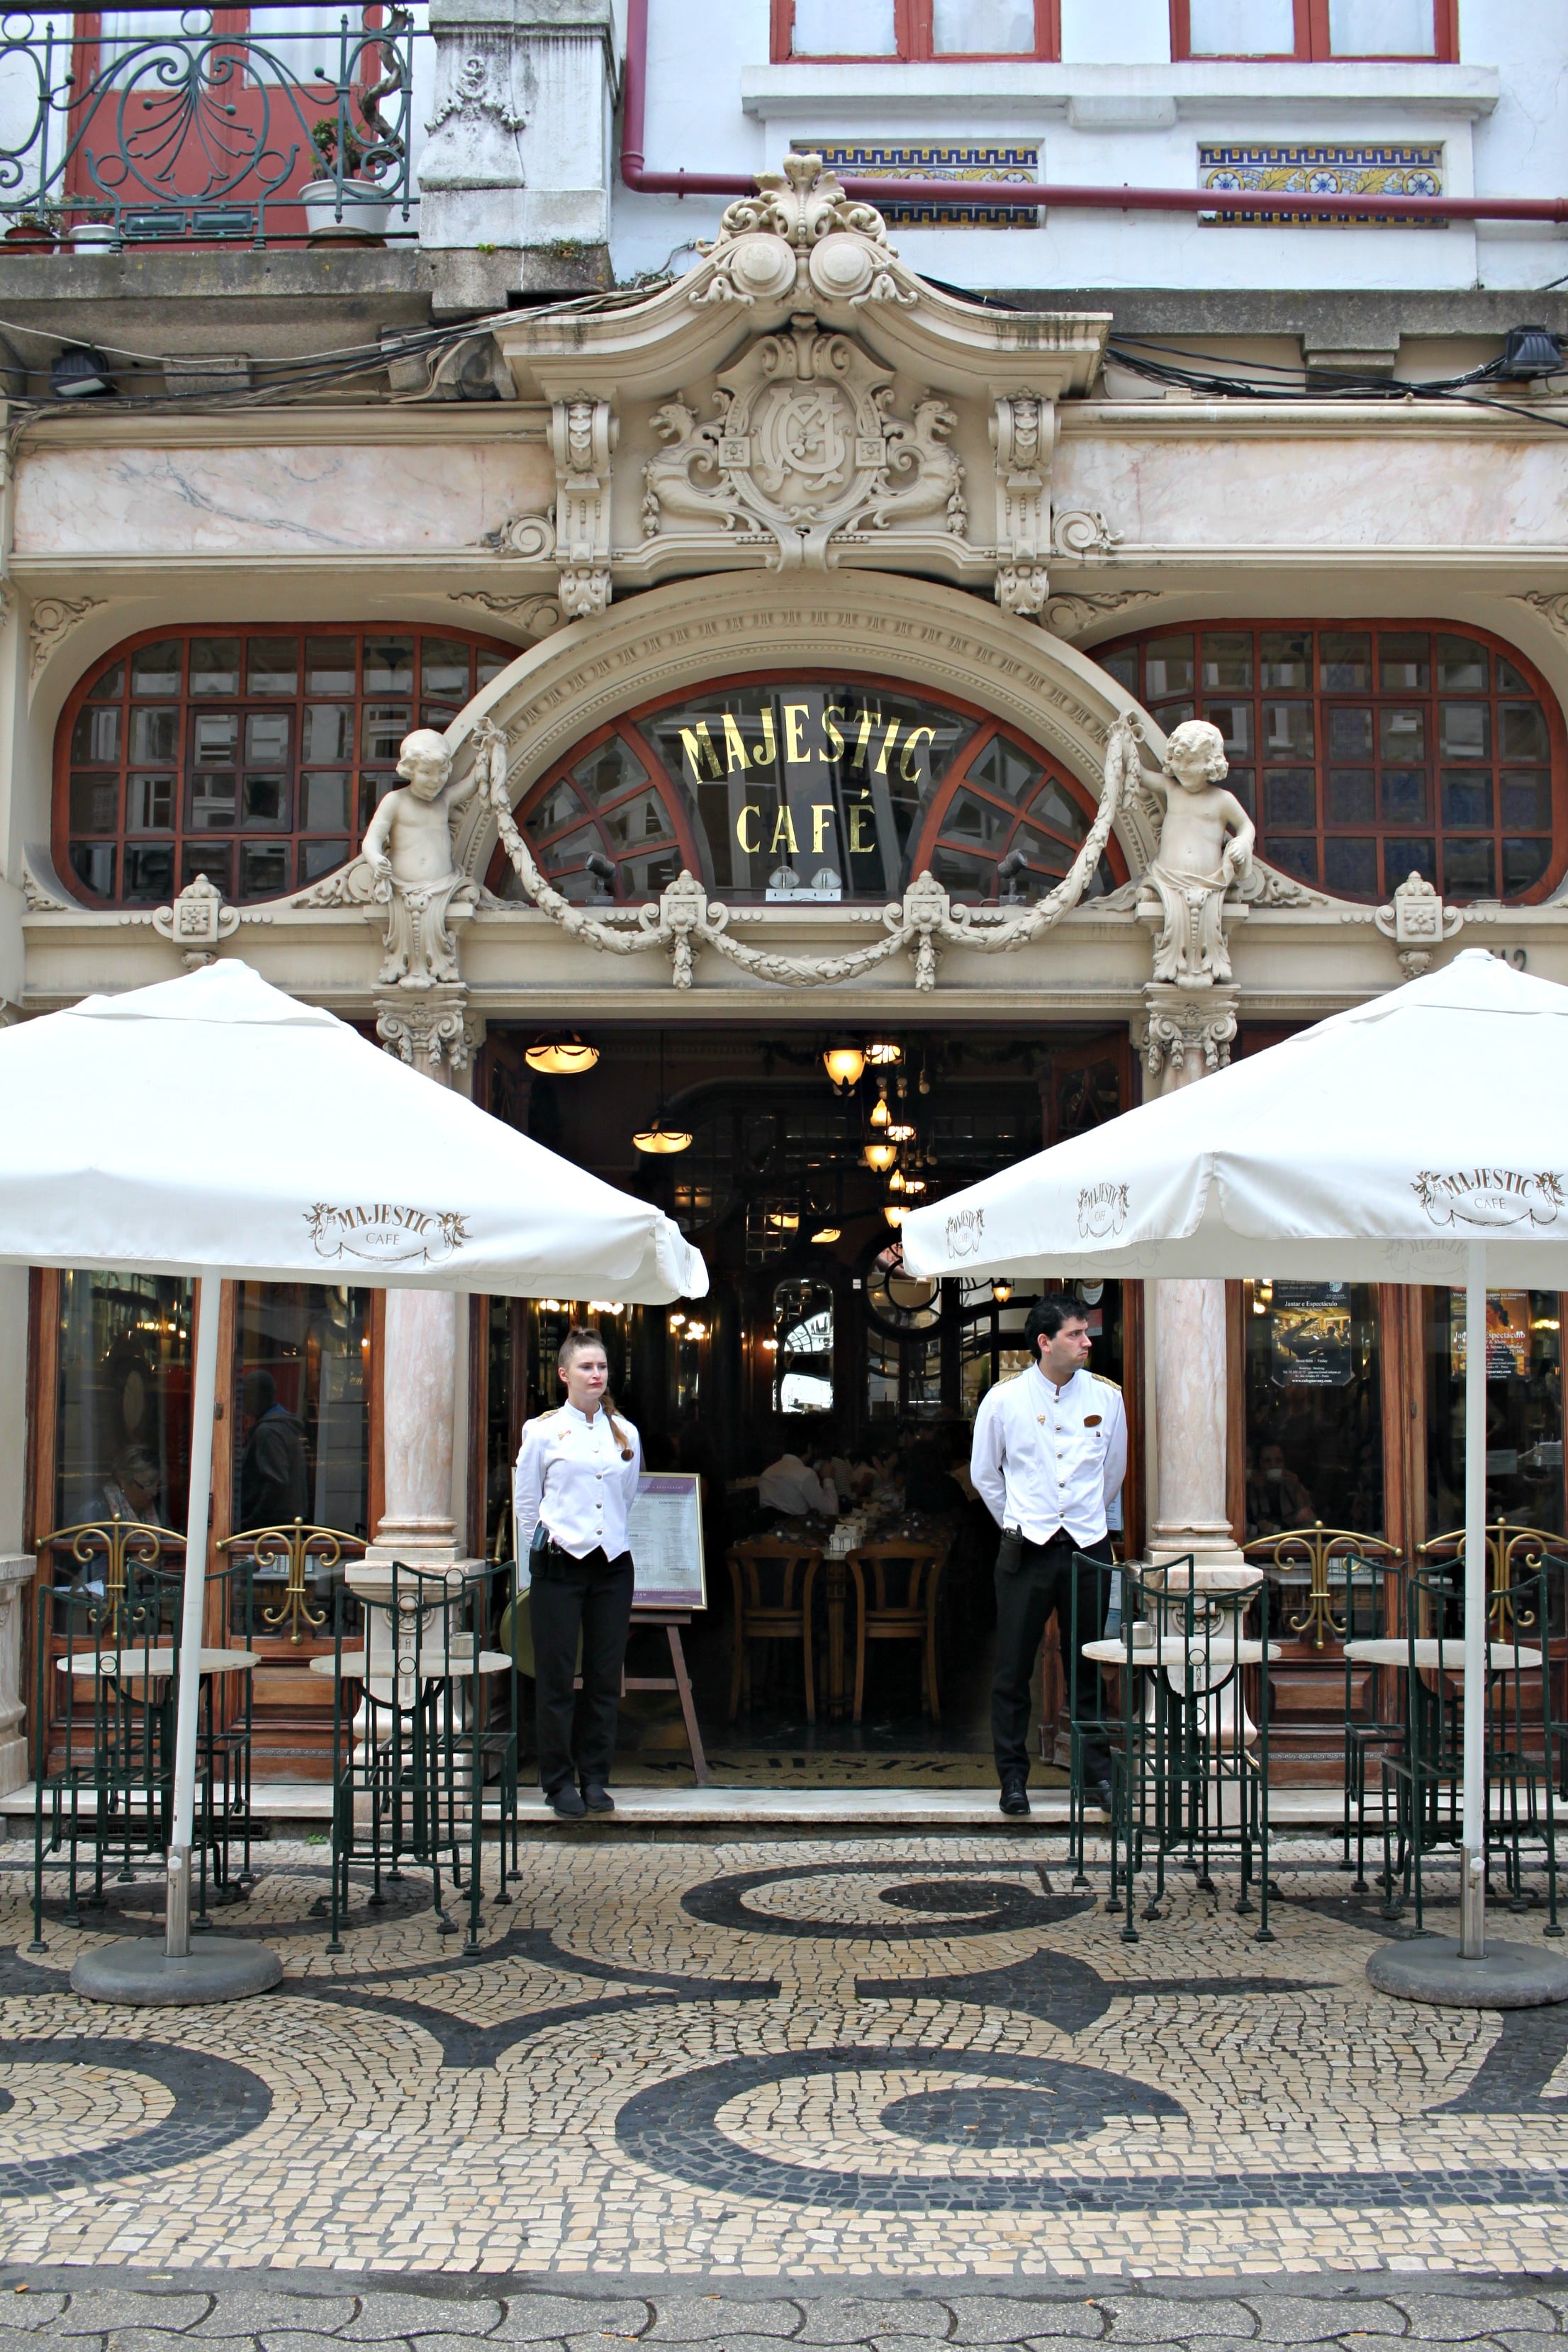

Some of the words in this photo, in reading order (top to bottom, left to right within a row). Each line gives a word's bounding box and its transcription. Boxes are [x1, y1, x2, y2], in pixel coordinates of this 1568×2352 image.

[678, 704, 936, 785] MAJESTIC
[737, 788, 875, 853] CAFÉ
[1441, 1168, 1534, 1199] MAJESTIC
[1474, 1197, 1506, 1209] CAFÉ
[338, 1204, 436, 1236] MAJESTIC
[643, 1757, 984, 1772] MAJESTIC
